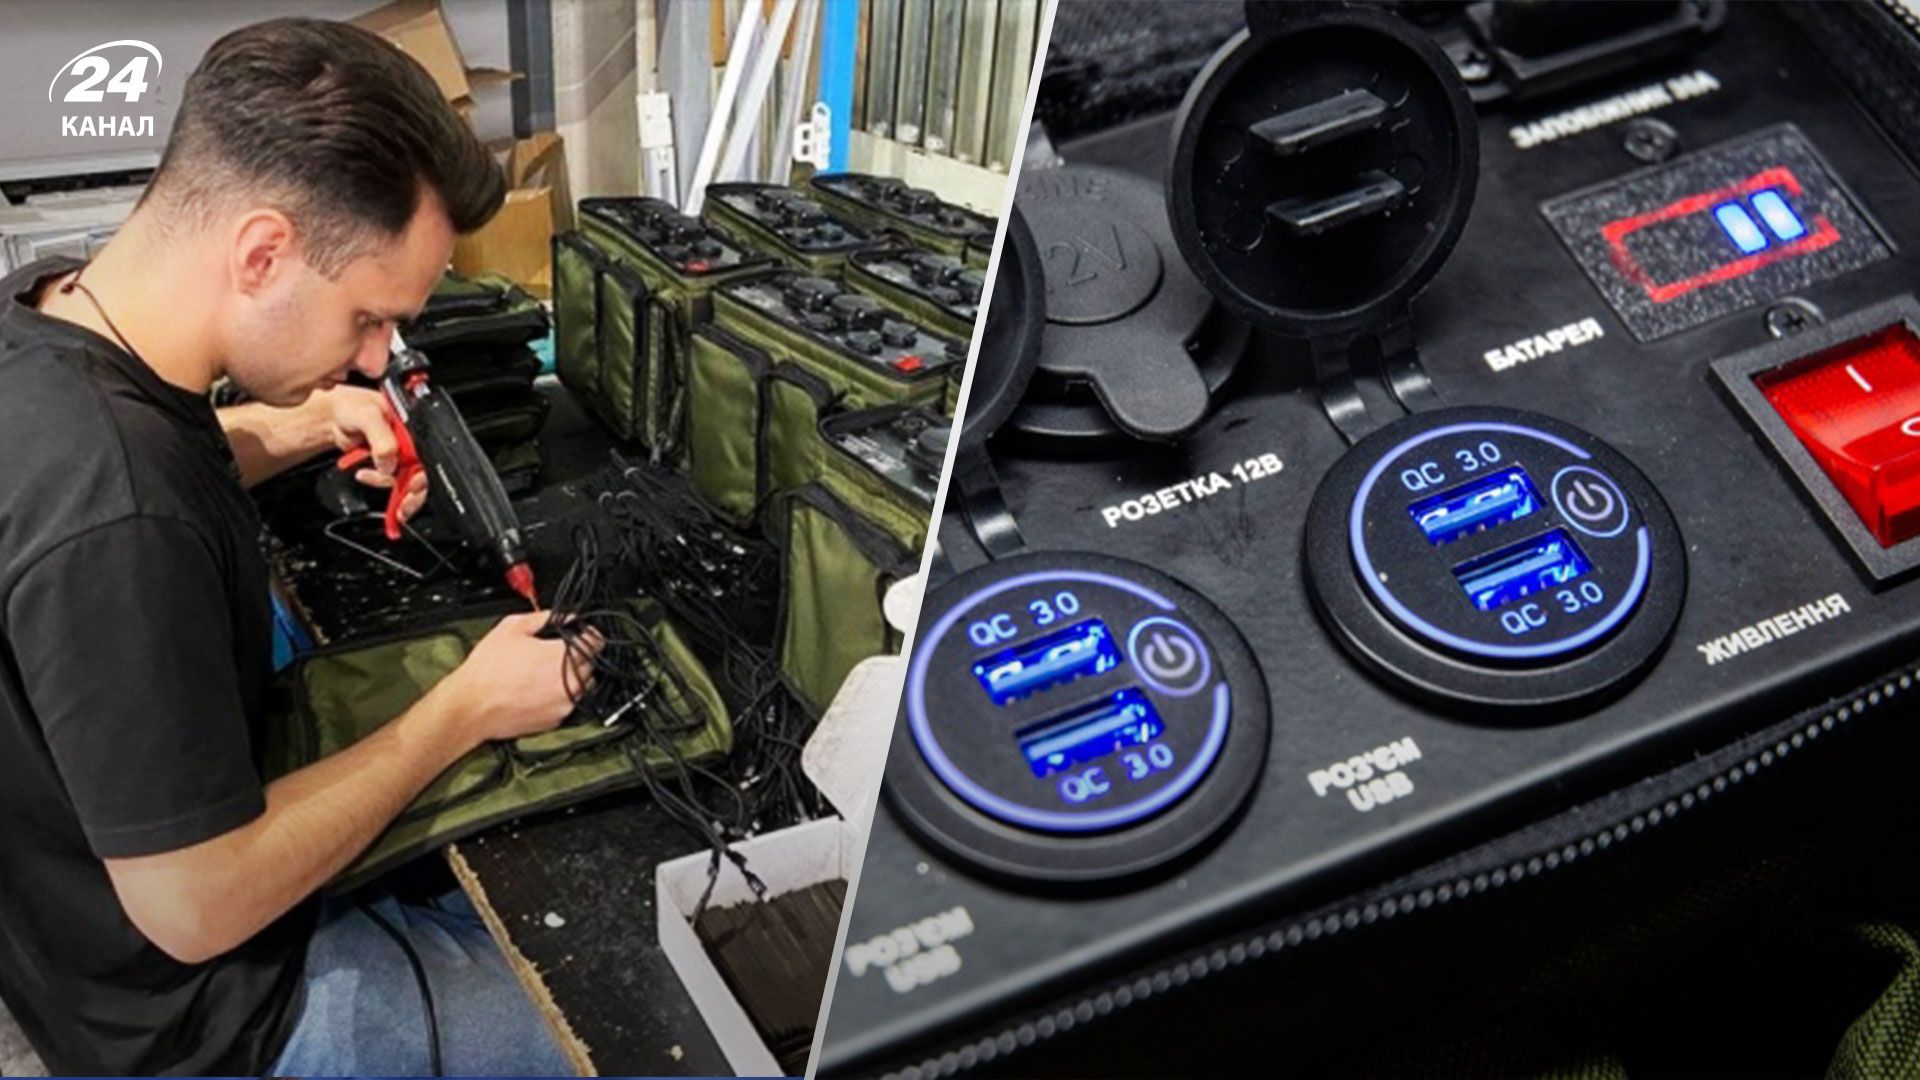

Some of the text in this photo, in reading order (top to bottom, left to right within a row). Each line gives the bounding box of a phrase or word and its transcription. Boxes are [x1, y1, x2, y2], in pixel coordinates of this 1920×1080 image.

[1483, 316, 1604, 372] БАТАРЕЯ
[1101, 452, 1284, 528] РОЗЕТКА 12В
[1401, 441, 1501, 492] QC 3.0
[967, 612, 1018, 647] QC
[1500, 581, 1604, 635] QC 3.0
[1696, 592, 1852, 665] ЖИВЛЕННЯ
[1059, 767, 1110, 802] QC
[1346, 770, 1415, 812] USB
